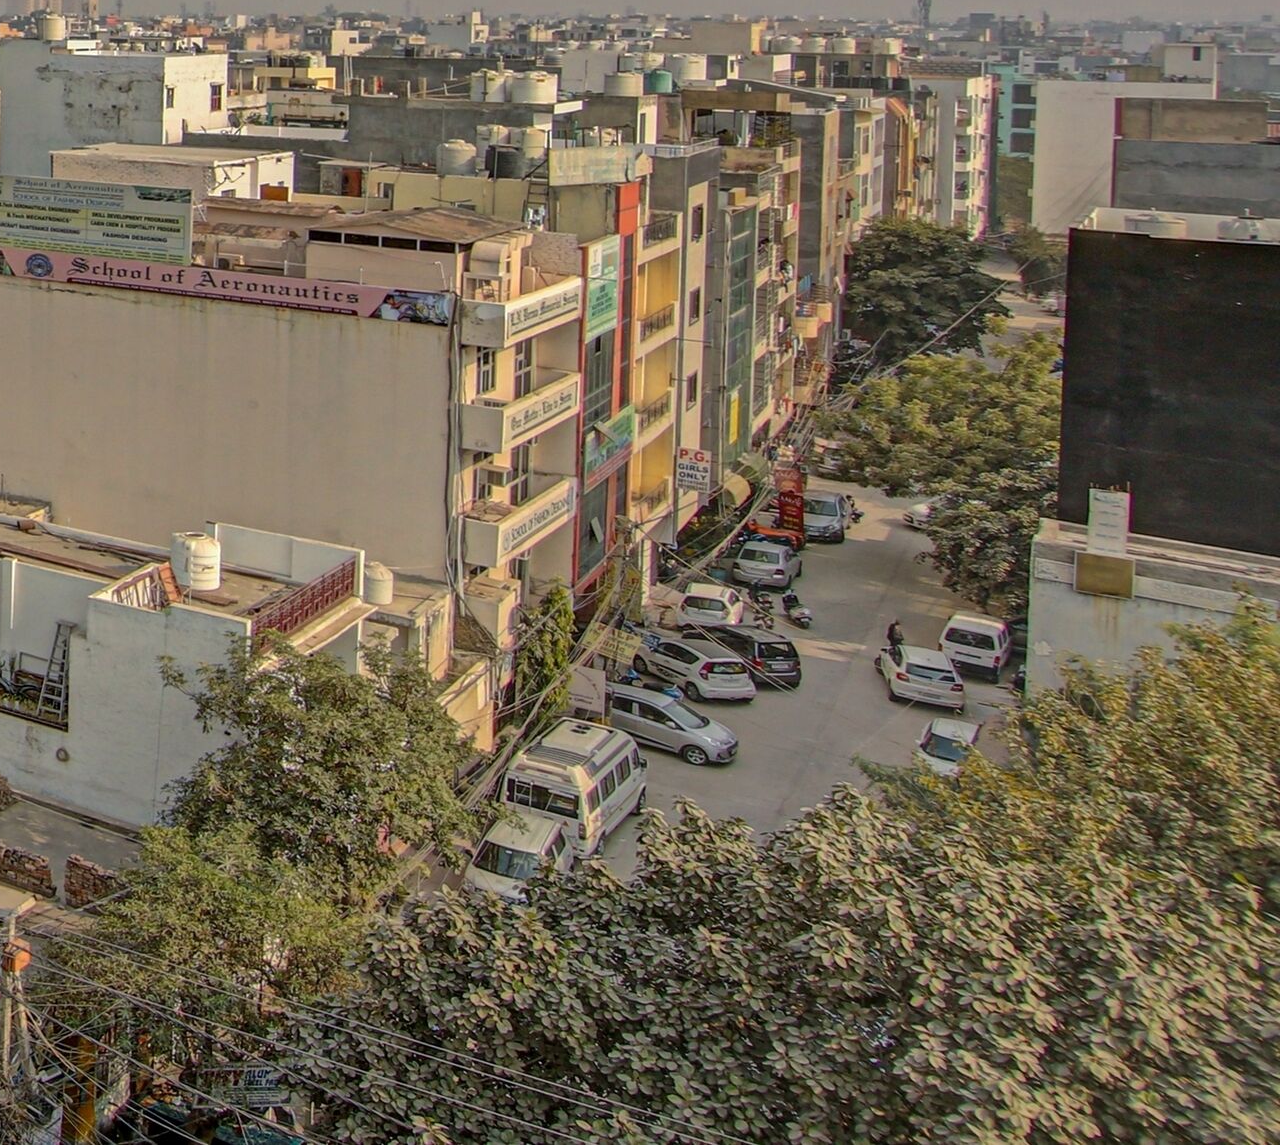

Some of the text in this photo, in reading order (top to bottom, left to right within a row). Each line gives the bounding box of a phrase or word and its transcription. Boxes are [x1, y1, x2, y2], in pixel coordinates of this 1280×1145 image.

[102, 232, 130, 240] FASHION
[66, 256, 152, 281] School
[161, 269, 187, 284] of
[193, 270, 360, 304] Aeronautics
[680, 449, 709, 463] P.G.
[678, 463, 708, 473] GIRLS
[679, 471, 707, 481] ONLY
